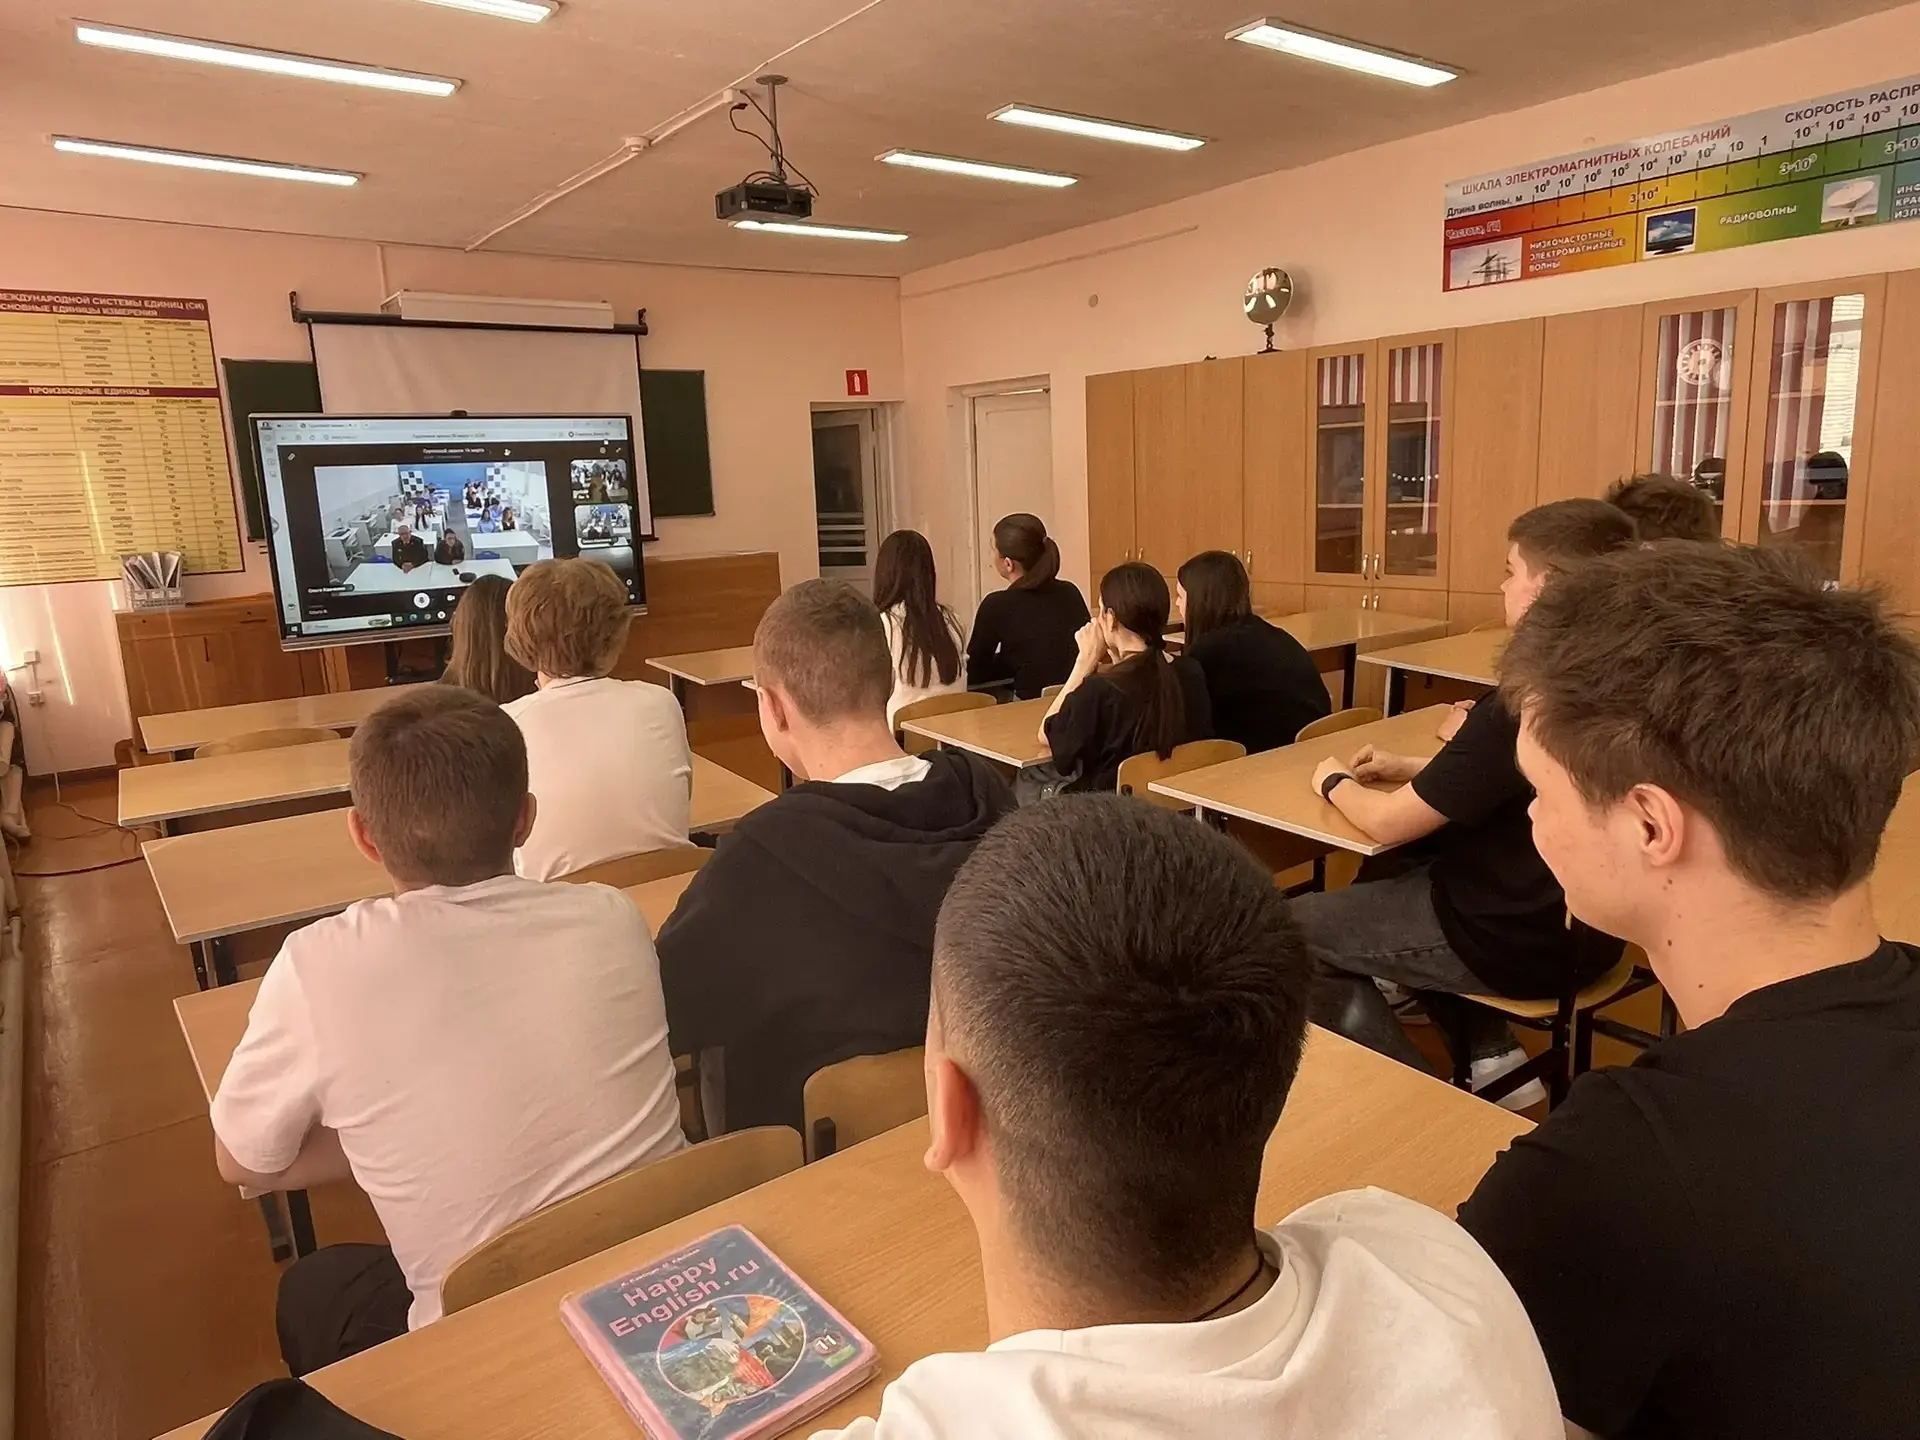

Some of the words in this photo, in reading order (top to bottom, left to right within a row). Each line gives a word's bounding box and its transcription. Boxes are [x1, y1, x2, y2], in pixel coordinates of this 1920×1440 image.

[1785, 97, 1865, 124] СКОРОСТЬ
[1869, 83, 1920, 106] РАСПР
[1462, 178, 1502, 195] ШКАЛА
[1505, 147, 1641, 186] ЭЛЕКТРОМАГНИТНЫХ
[1644, 124, 1732, 156] КОЛЕБАНИЙ
[1447, 206, 1476, 218] Длина
[1729, 141, 1744, 154] 10
[1761, 135, 1768, 146] 1
[1720, 205, 1797, 224] РАДИОВОЛНЫ
[1530, 228, 1614, 249] НИЗКОЧАСТОТНЫЕ
[1530, 239, 1625, 260] ЭЛЕКТРОМАГНИТНЫЕ
[1529, 261, 1560, 273] ВОЛНЫ
[92, 297, 142, 307] СИСТЕМЫ
[144, 300, 184, 310] ЕДИНИЦ
[28, 386, 102, 395] ПРОИЗВОДНЫЕ
[104, 387, 150, 396] ЕДИНИЦЫ
[622, 1257, 717, 1307] Happy
[815, 1334, 837, 1350] 11
